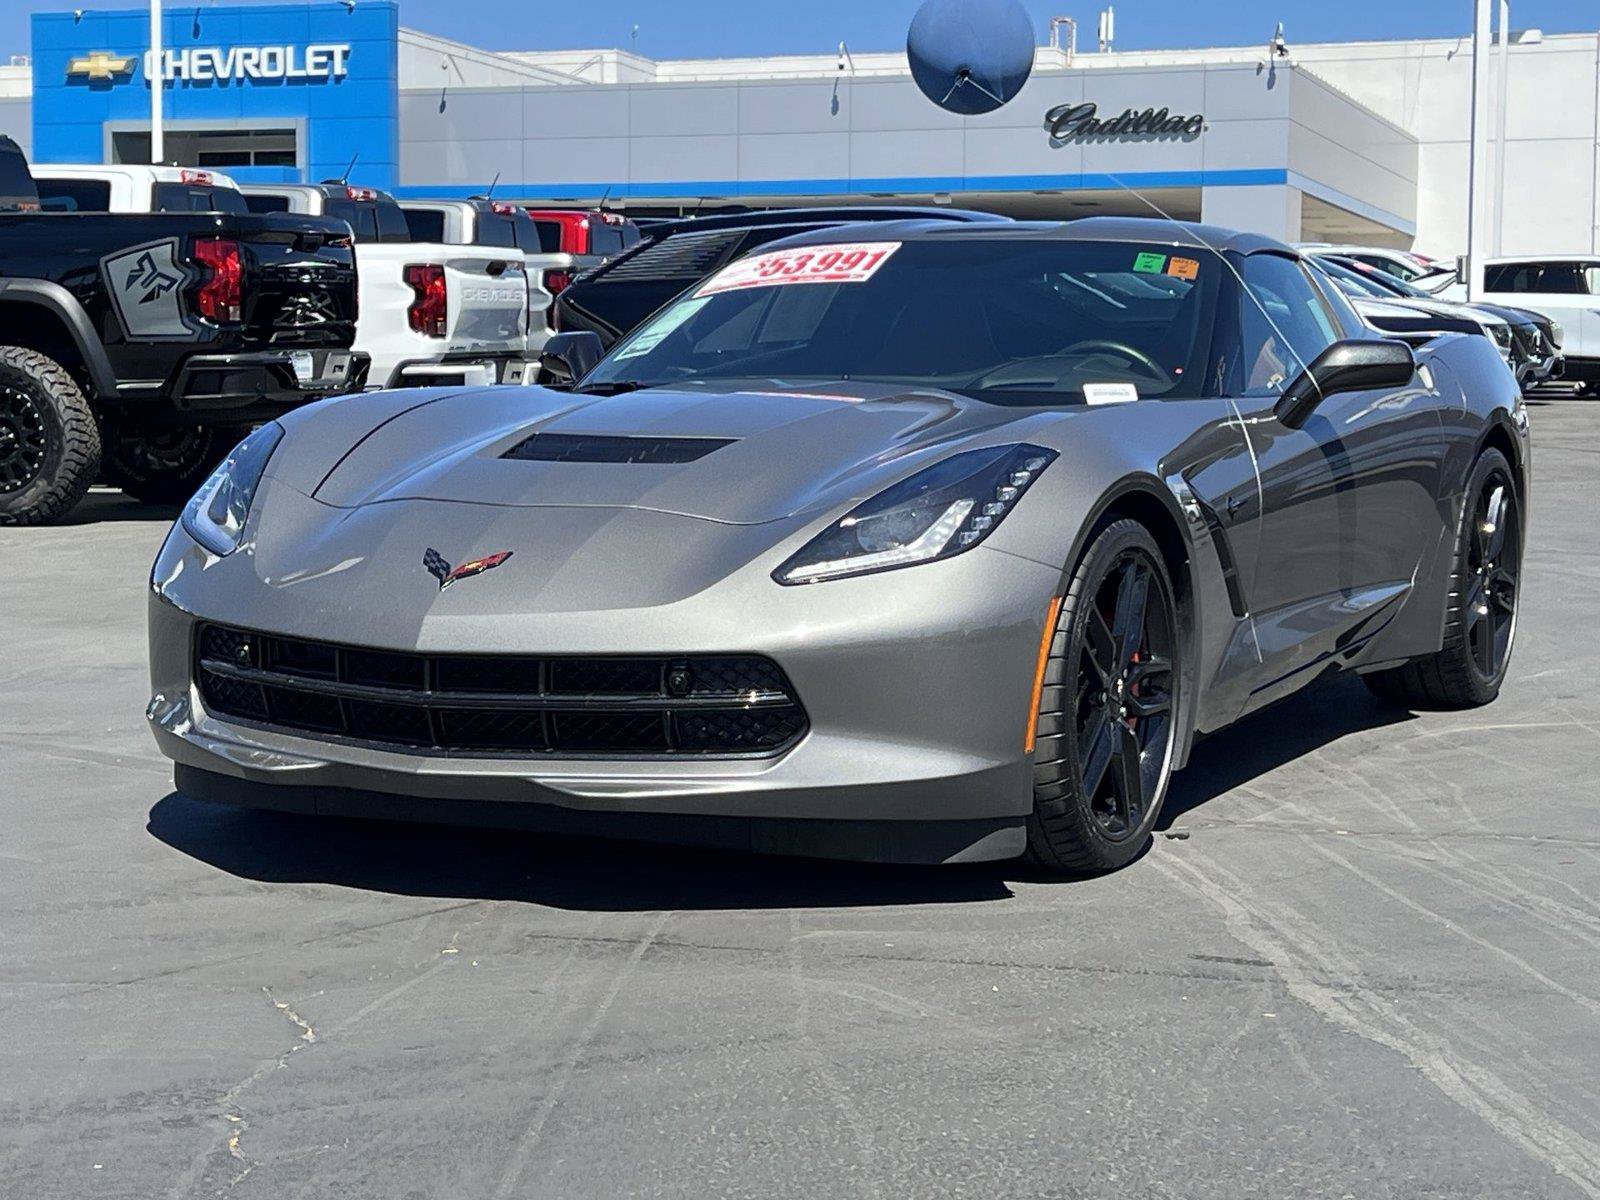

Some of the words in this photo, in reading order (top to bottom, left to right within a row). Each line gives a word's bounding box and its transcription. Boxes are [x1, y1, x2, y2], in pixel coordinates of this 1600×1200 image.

[143, 44, 350, 80] CHEVROLET
[1044, 103, 1204, 140] Cadillac
[463, 287, 525, 302] CHEVROLE
